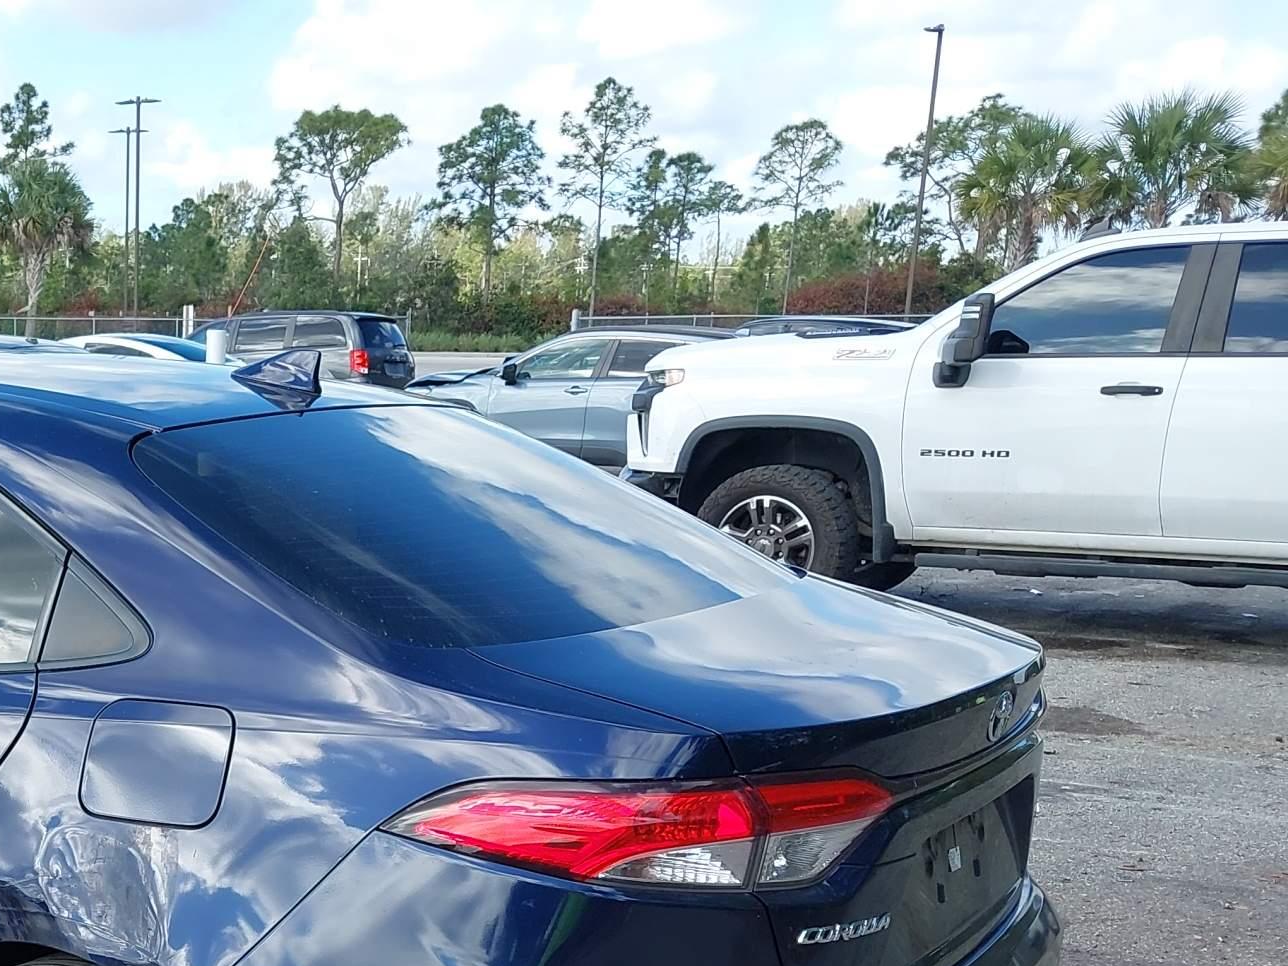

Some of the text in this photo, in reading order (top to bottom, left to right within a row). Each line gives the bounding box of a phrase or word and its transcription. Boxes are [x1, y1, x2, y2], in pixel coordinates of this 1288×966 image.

[919, 448, 1010, 458] 2500 HD
[796, 913, 891, 944] COROLLA
